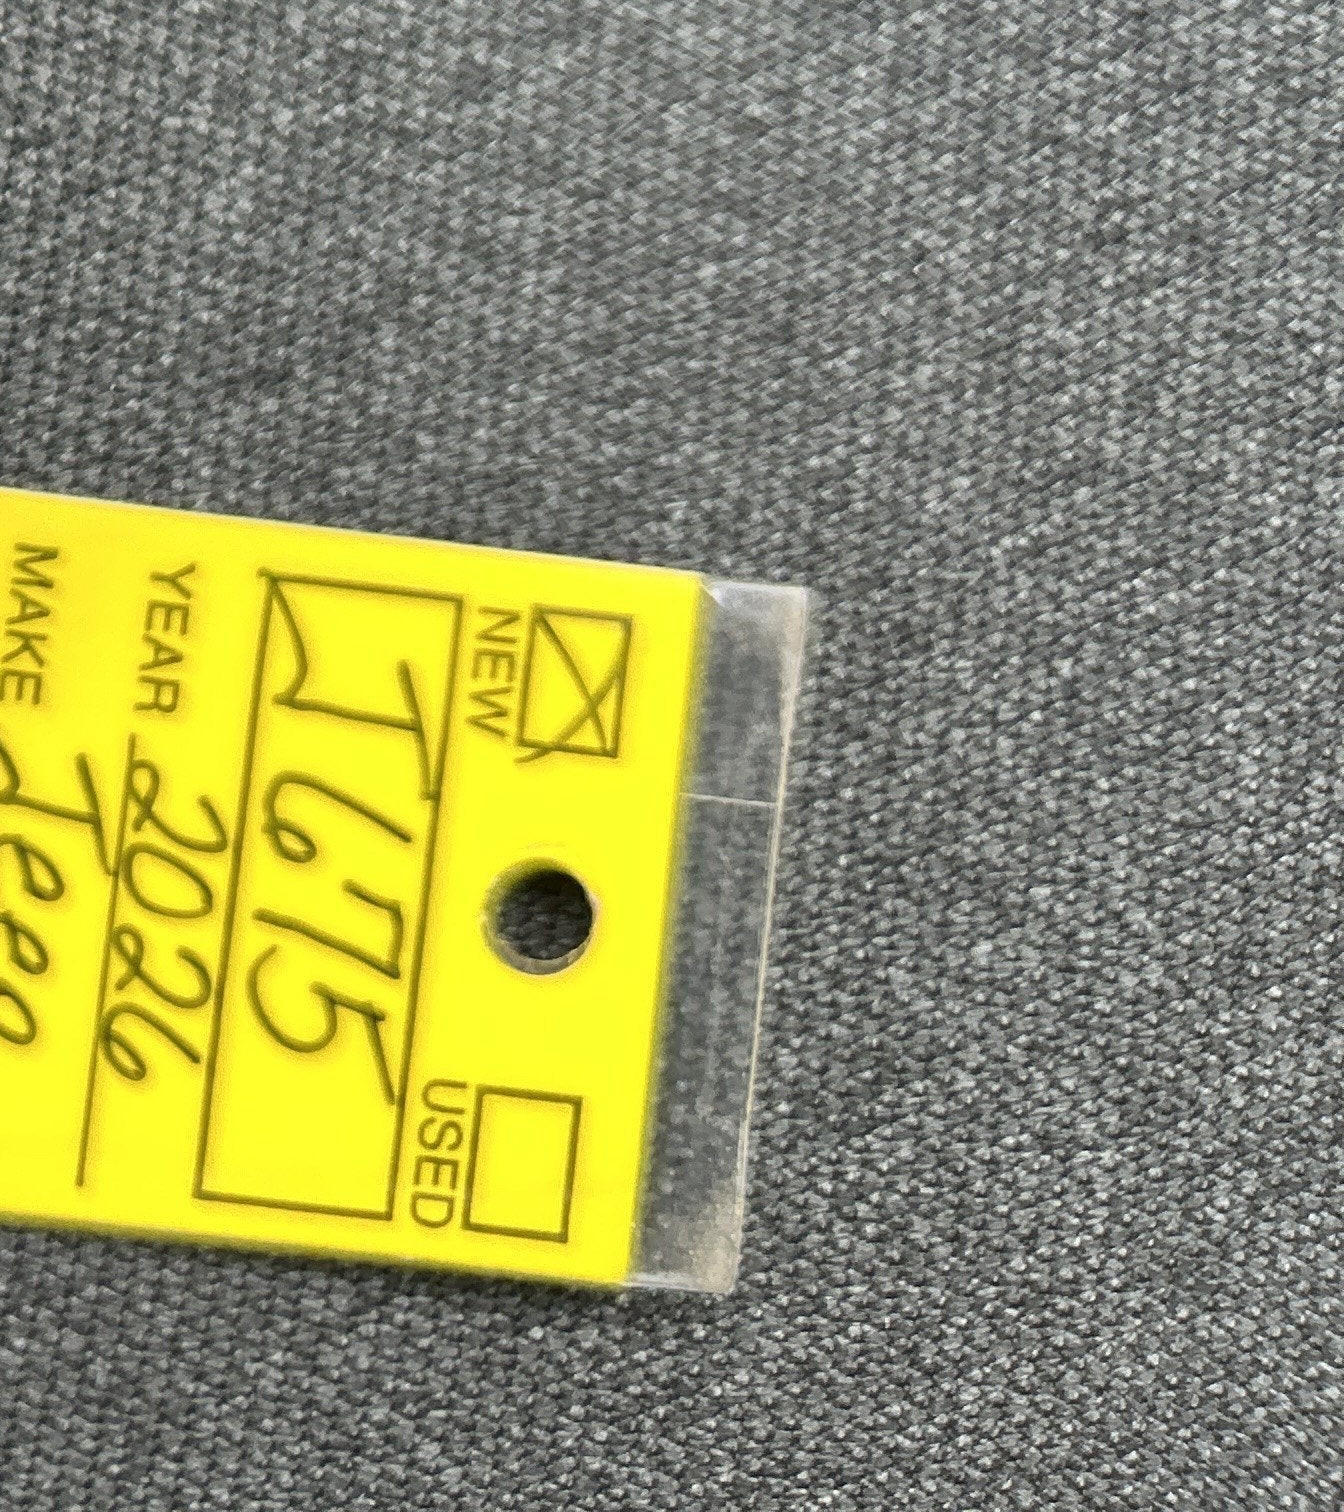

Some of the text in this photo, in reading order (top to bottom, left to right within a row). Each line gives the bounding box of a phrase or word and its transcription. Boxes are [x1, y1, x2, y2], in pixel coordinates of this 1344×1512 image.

[133, 561, 198, 717] YEAR
[468, 605, 522, 741] NEW
[99, 756, 228, 1083] 2026
[247, 578, 440, 1107] J675
[409, 1077, 468, 1231] USED
